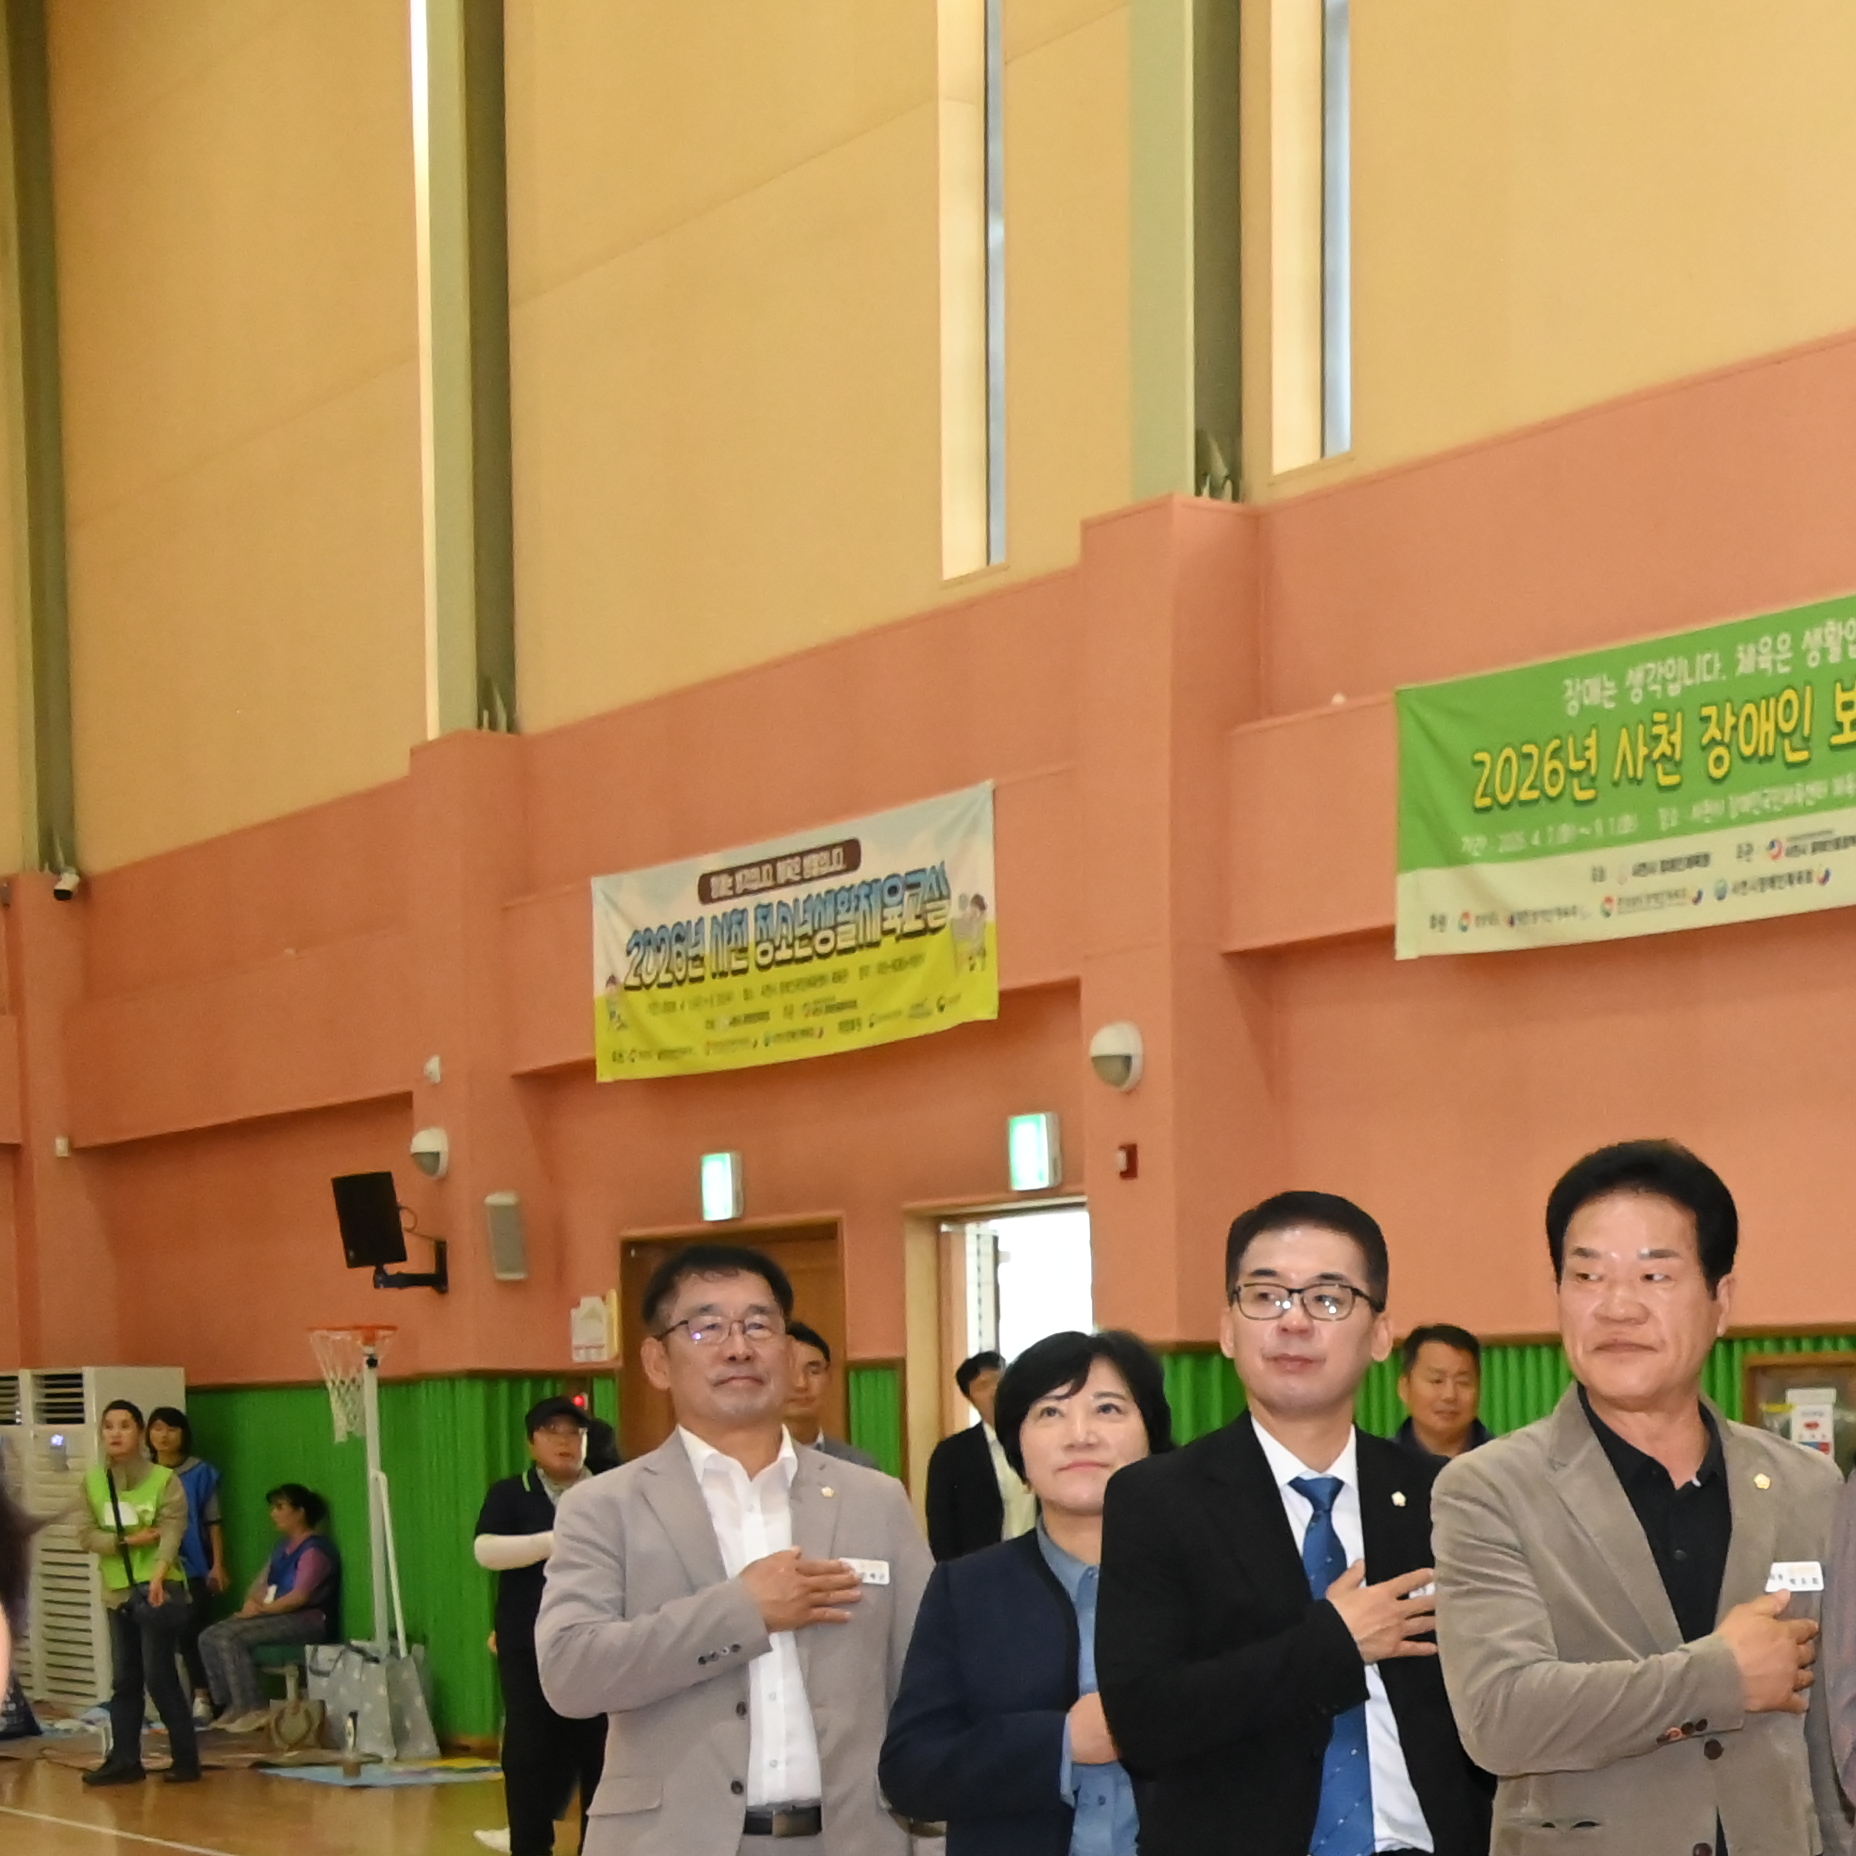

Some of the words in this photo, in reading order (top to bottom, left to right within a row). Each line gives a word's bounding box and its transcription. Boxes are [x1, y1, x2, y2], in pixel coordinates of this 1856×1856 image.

[1471, 727, 1600, 811] 2026년
[1613, 708, 1684, 788] 사천
[1699, 672, 1815, 780] 장애인
[624, 919, 705, 991] 2026년
